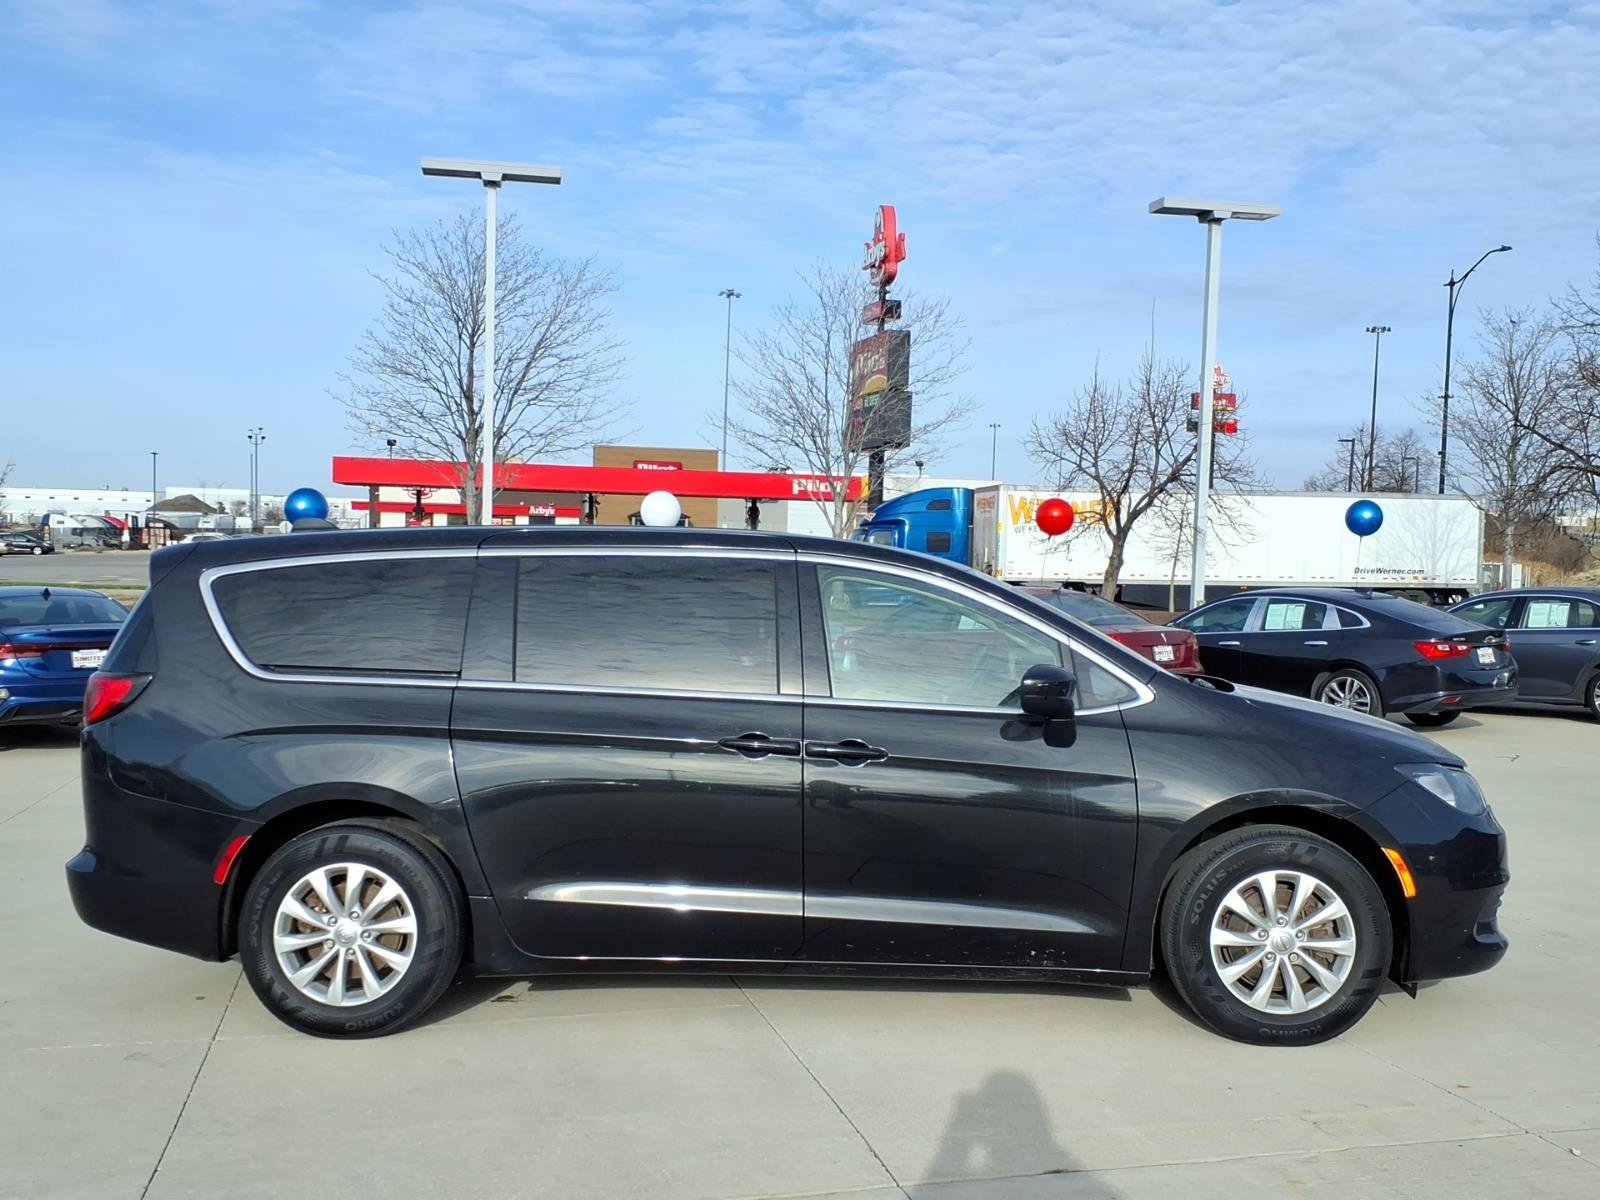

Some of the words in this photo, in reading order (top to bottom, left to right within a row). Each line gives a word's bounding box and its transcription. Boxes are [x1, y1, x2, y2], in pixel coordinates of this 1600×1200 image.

[528, 504, 556, 516] Arby's
[1353, 567, 1425, 575] DriveWerner.com
[1191, 868, 1228, 925] SOLUS
